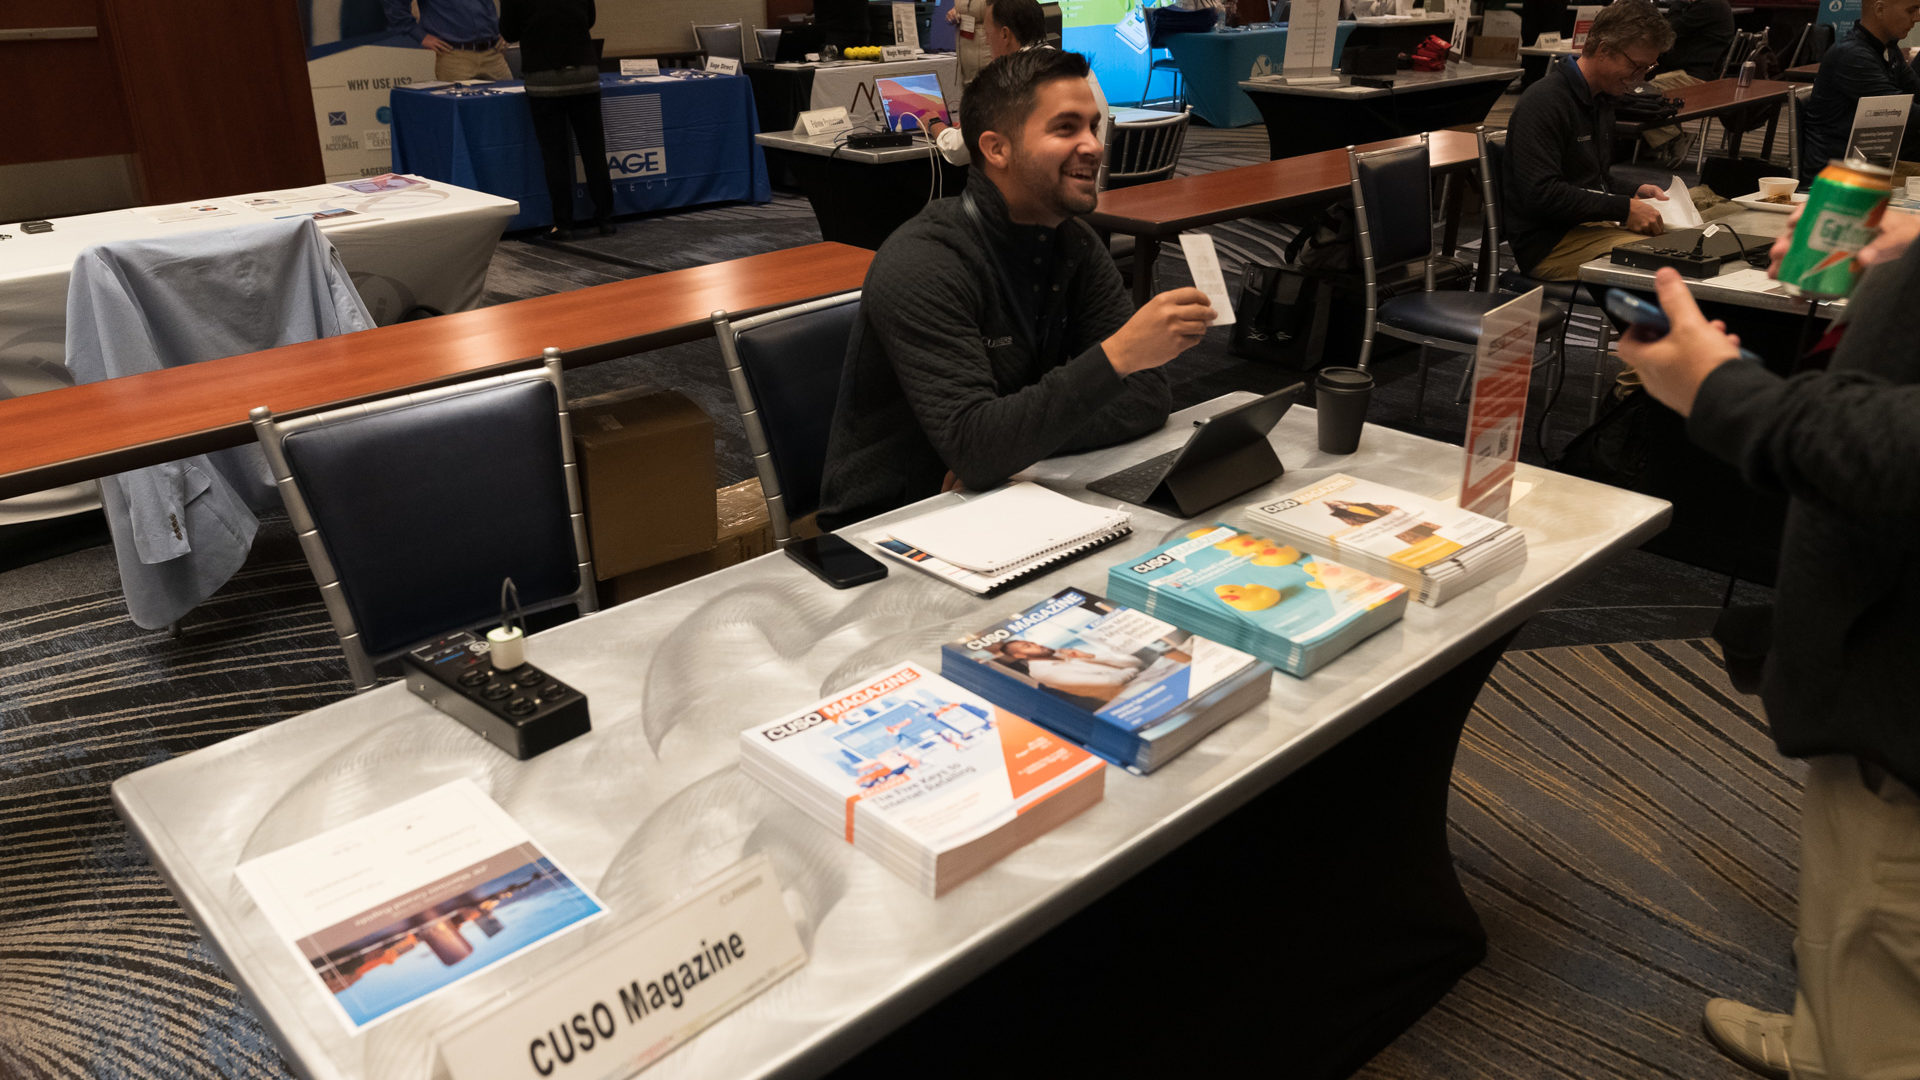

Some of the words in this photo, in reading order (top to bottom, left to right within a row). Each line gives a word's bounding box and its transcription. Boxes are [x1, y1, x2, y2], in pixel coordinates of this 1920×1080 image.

[347, 79, 370, 91] WHY
[372, 78, 392, 90] USE
[325, 141, 359, 151] ACCURATE
[607, 151, 660, 175] AGE
[1262, 499, 1299, 514] CUSO
[1133, 553, 1173, 575] CUSO
[966, 629, 1011, 652] CUSO
[1006, 592, 1080, 635] MAGAZINE
[765, 712, 823, 741] CUSO
[824, 669, 918, 719] MAGAZINE
[527, 1001, 616, 1077] CUSO
[618, 931, 746, 1025] Magazine
